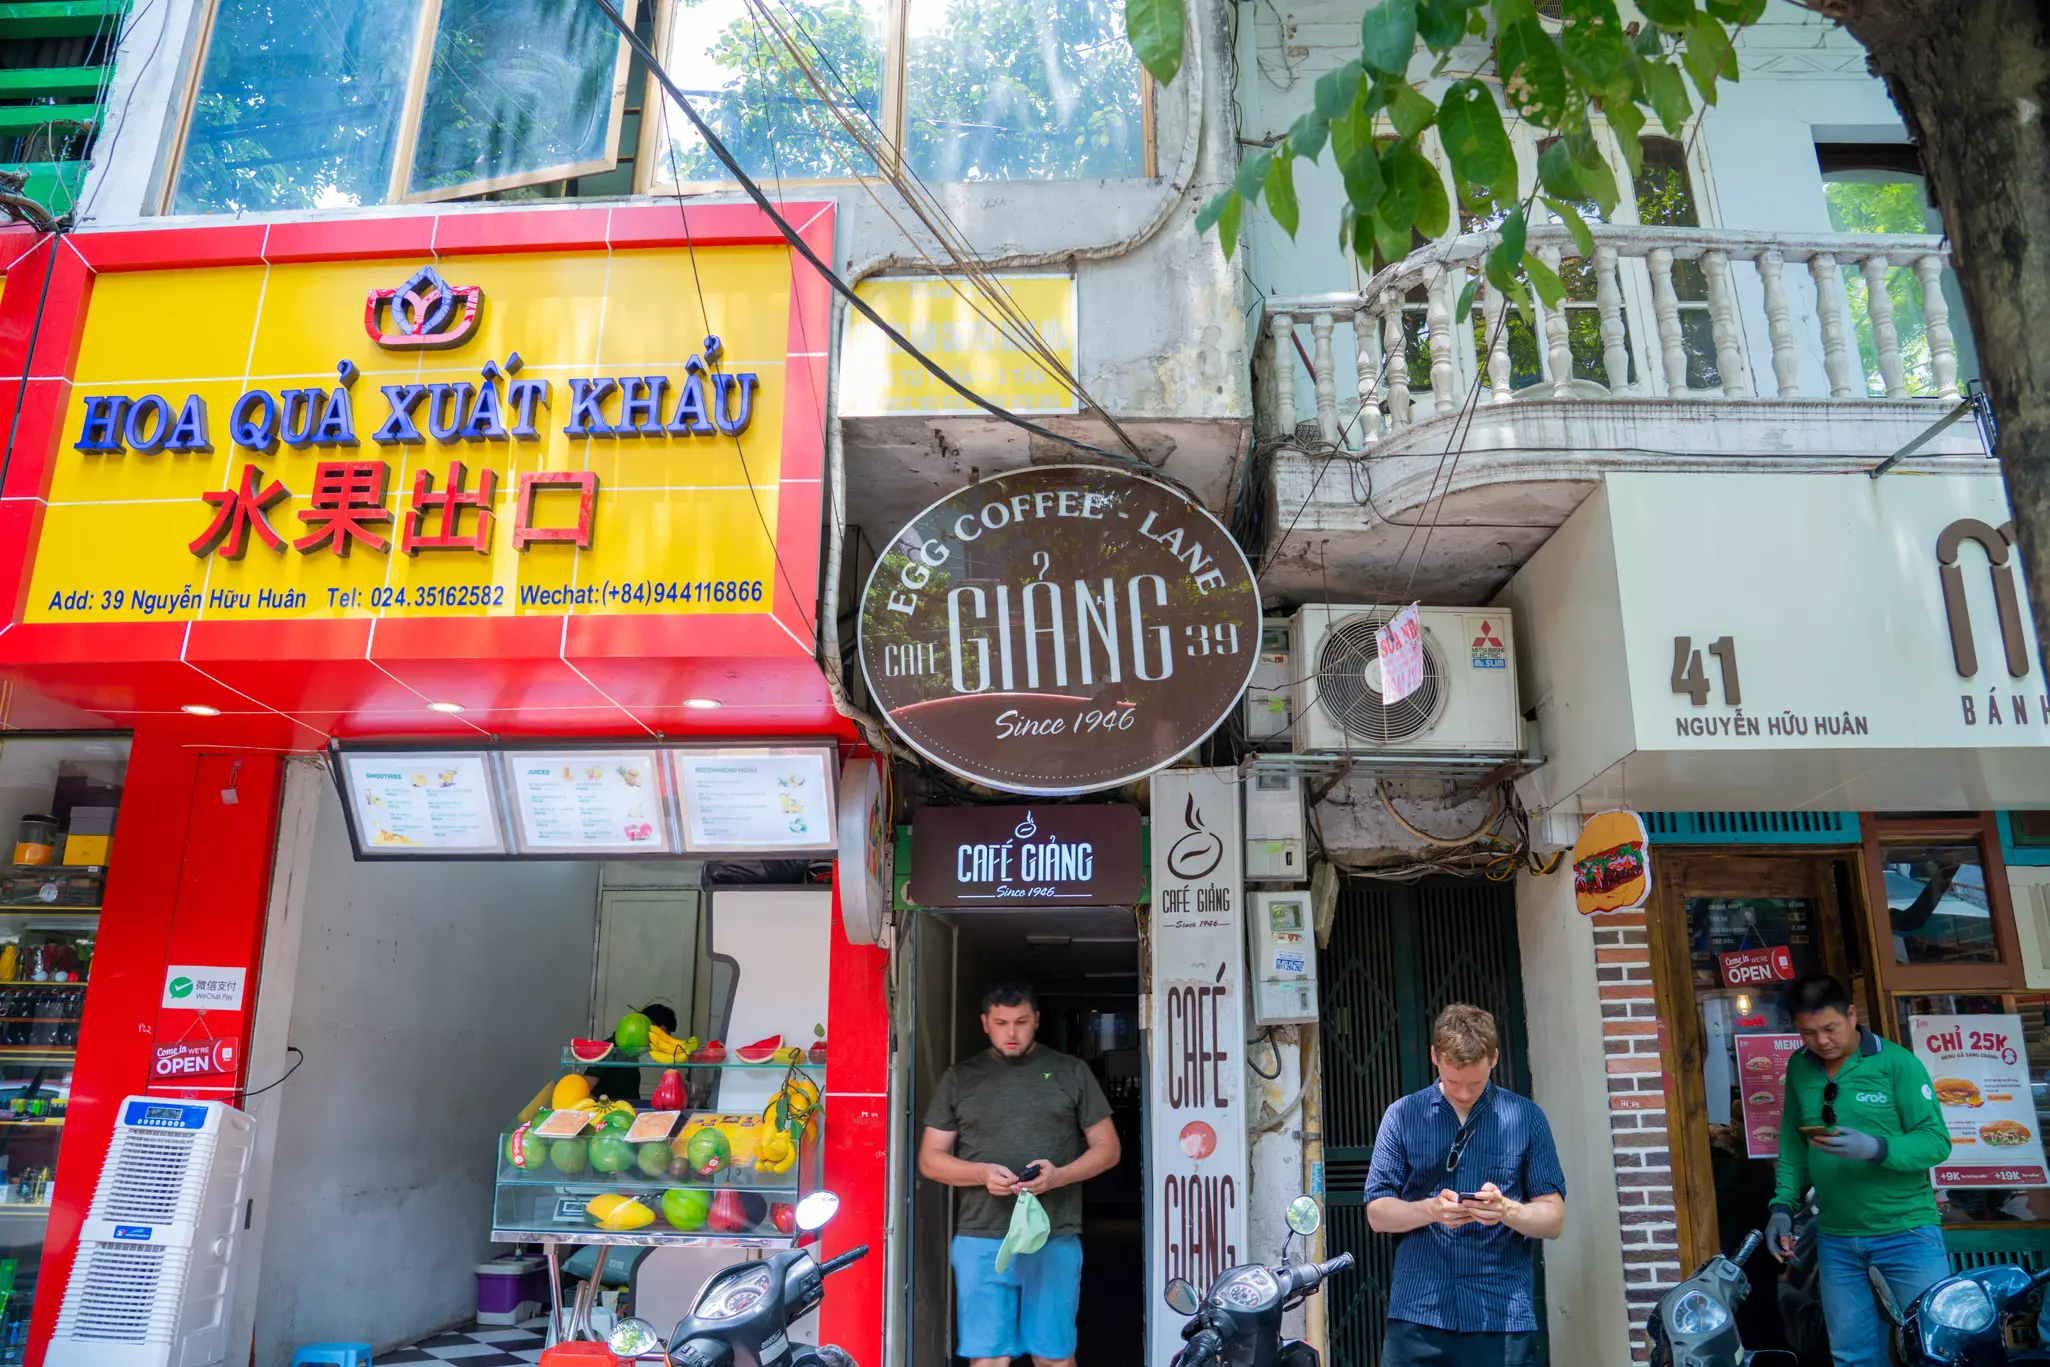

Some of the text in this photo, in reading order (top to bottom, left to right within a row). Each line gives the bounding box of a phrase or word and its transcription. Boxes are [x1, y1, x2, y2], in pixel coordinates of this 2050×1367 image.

[74, 334, 759, 455] HOA QUẢ XUẤT KHẨU
[188, 460, 600, 562] 水果出口
[887, 537, 950, 616] EGG
[954, 491, 1104, 542] COFFEE
[1137, 508, 1227, 596] LANE
[49, 590, 94, 610] Add:
[100, 589, 124, 609] 39
[131, 583, 202, 614] Nguyễn
[209, 589, 250, 609] Hữu
[257, 588, 306, 608] Huân
[327, 587, 362, 607] Tel:
[371, 586, 505, 607] 024.35162582
[947, 551, 1175, 694] GIẢNG
[1185, 622, 1239, 657] 39
[1671, 636, 1741, 706] 41
[995, 706, 1135, 740] Since 1946
[1676, 708, 1869, 737] NGUYỄN HỮU HUÂN
[365, 772, 402, 780] SMOOTHIES
[957, 835, 1094, 883] CAFÉ GIẢNG
[996, 885, 1056, 898] Since 1946
[1162, 882, 1231, 914] CAFÉ GIẢNG
[1175, 920, 1219, 929] Since 1946
[195, 979, 238, 992] 微信支付
[1728, 964, 1772, 984] OPEN
[195, 992, 233, 1002] WeChat Pay
[1167, 962, 1229, 1109] CAFÉ
[1774, 1039, 1803, 1050] MENU
[1926, 1024, 2009, 1054] CHỈ 25K
[156, 1055, 209, 1075] OPEN
[157, 1044, 210, 1058] Come in WE'RE
[1856, 1091, 1888, 1103] Grab
